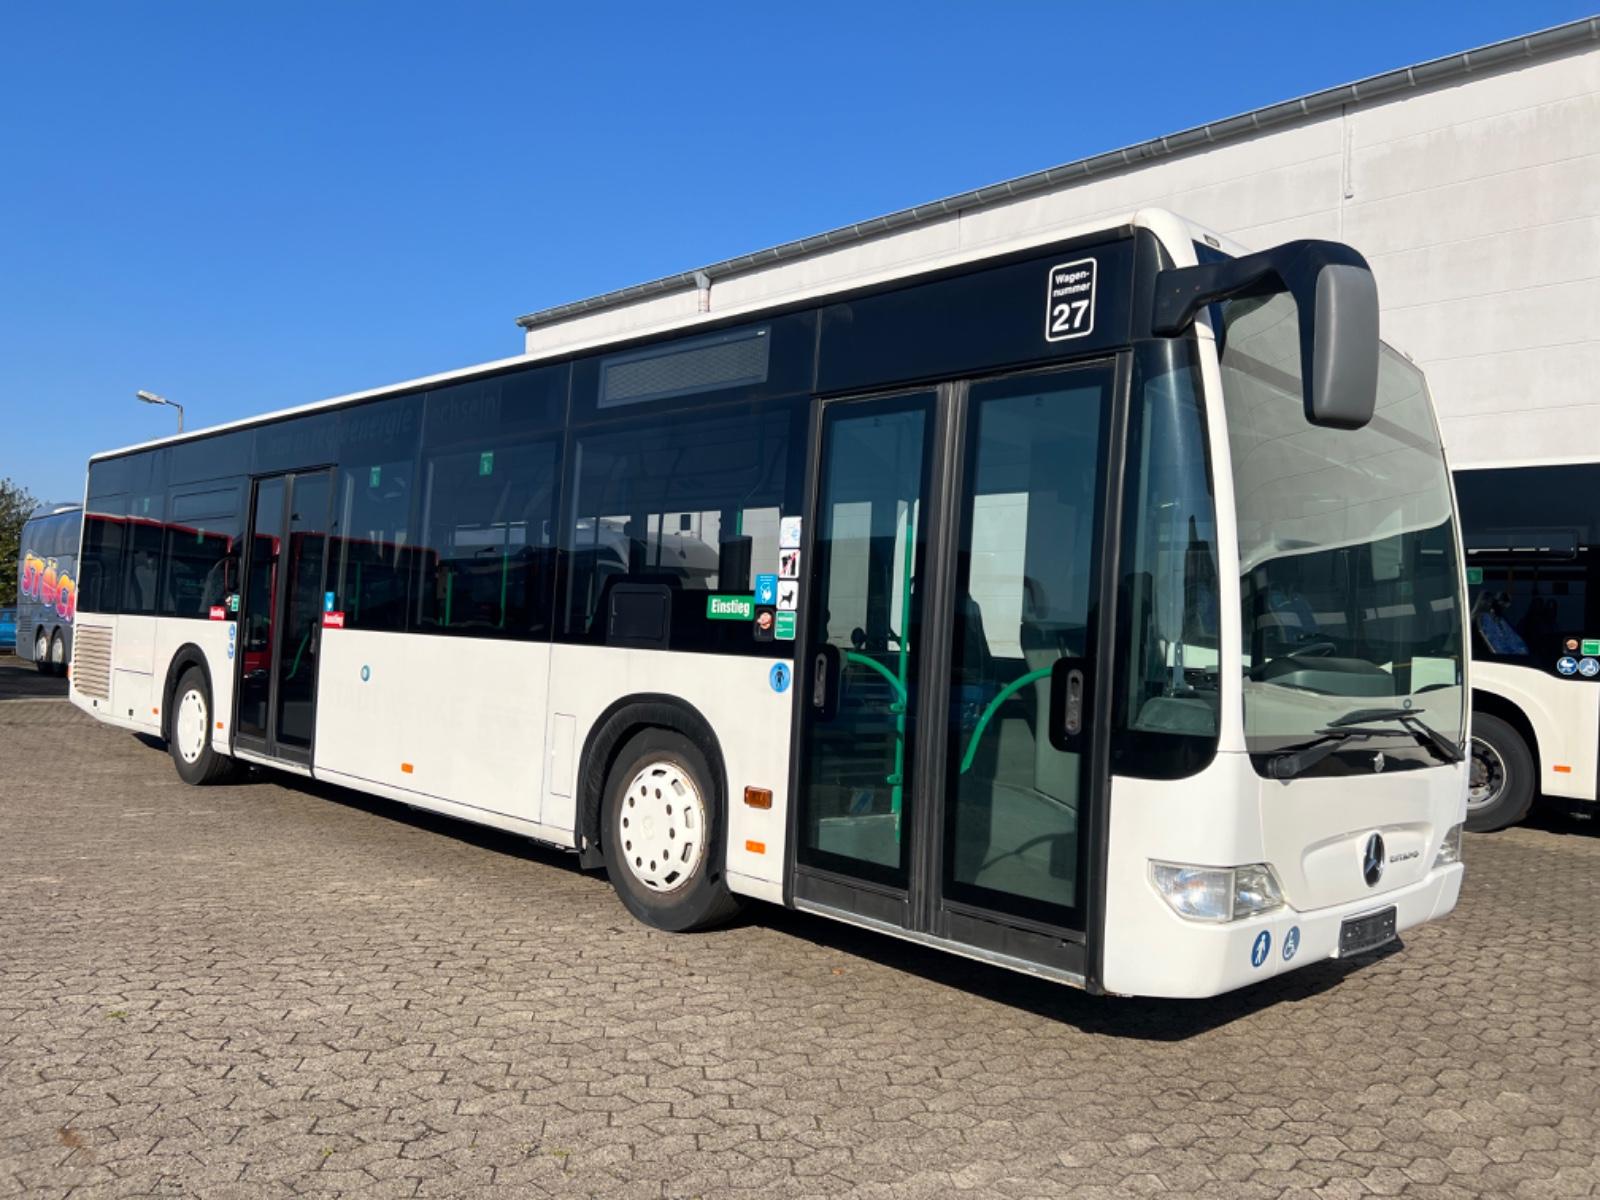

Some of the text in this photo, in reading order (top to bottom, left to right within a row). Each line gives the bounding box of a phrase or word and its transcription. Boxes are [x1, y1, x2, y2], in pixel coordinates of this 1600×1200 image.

[1055, 271, 1090, 284] Wagen-
[1053, 282, 1091, 297] nummer
[1052, 299, 1090, 332] 27
[711, 598, 750, 618] Einstieg
